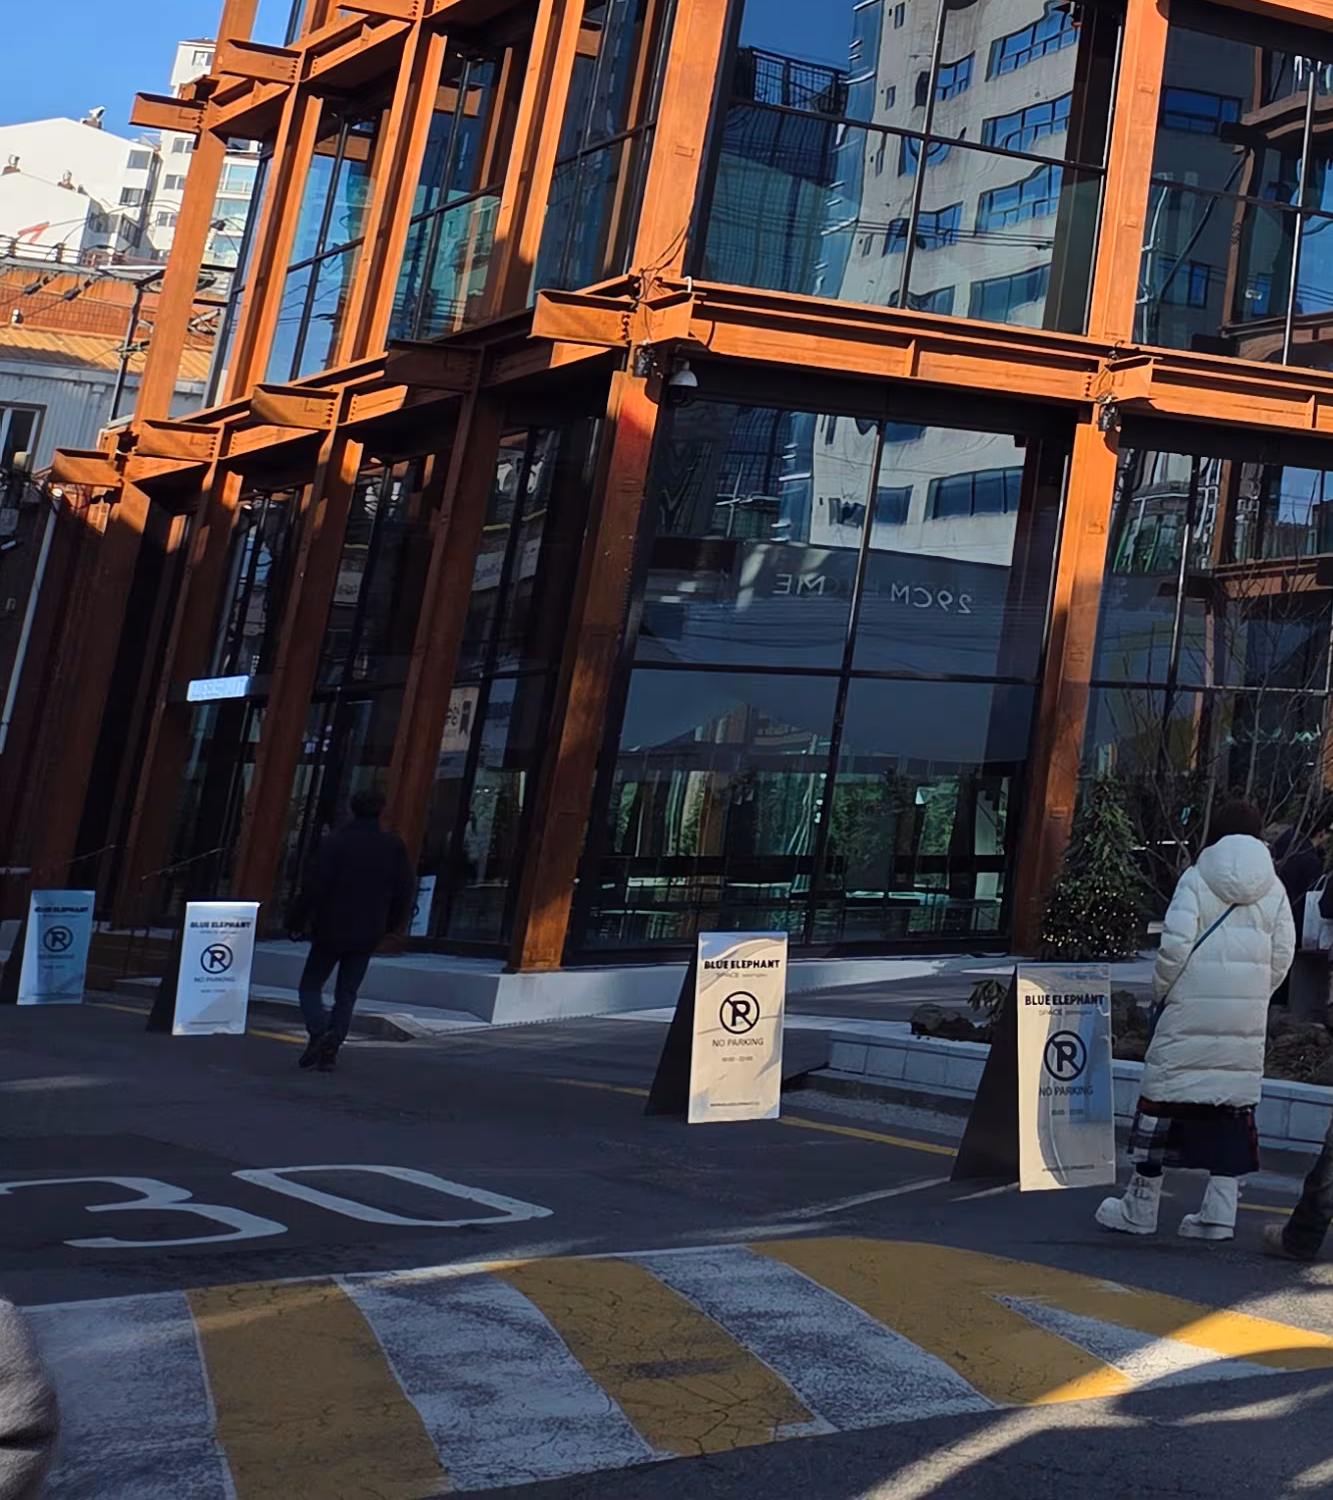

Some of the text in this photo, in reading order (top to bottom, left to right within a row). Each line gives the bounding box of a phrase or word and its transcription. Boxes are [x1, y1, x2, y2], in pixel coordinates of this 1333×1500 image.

[704, 959, 780, 970] BLUE ELEPHANT
[1025, 993, 1105, 1006] BLUE ELEPHANT
[712, 1037, 764, 1047] NO PARKING
[1039, 1085, 1094, 1097] NO PARKING
[0, 1164, 554, 1248] 30
